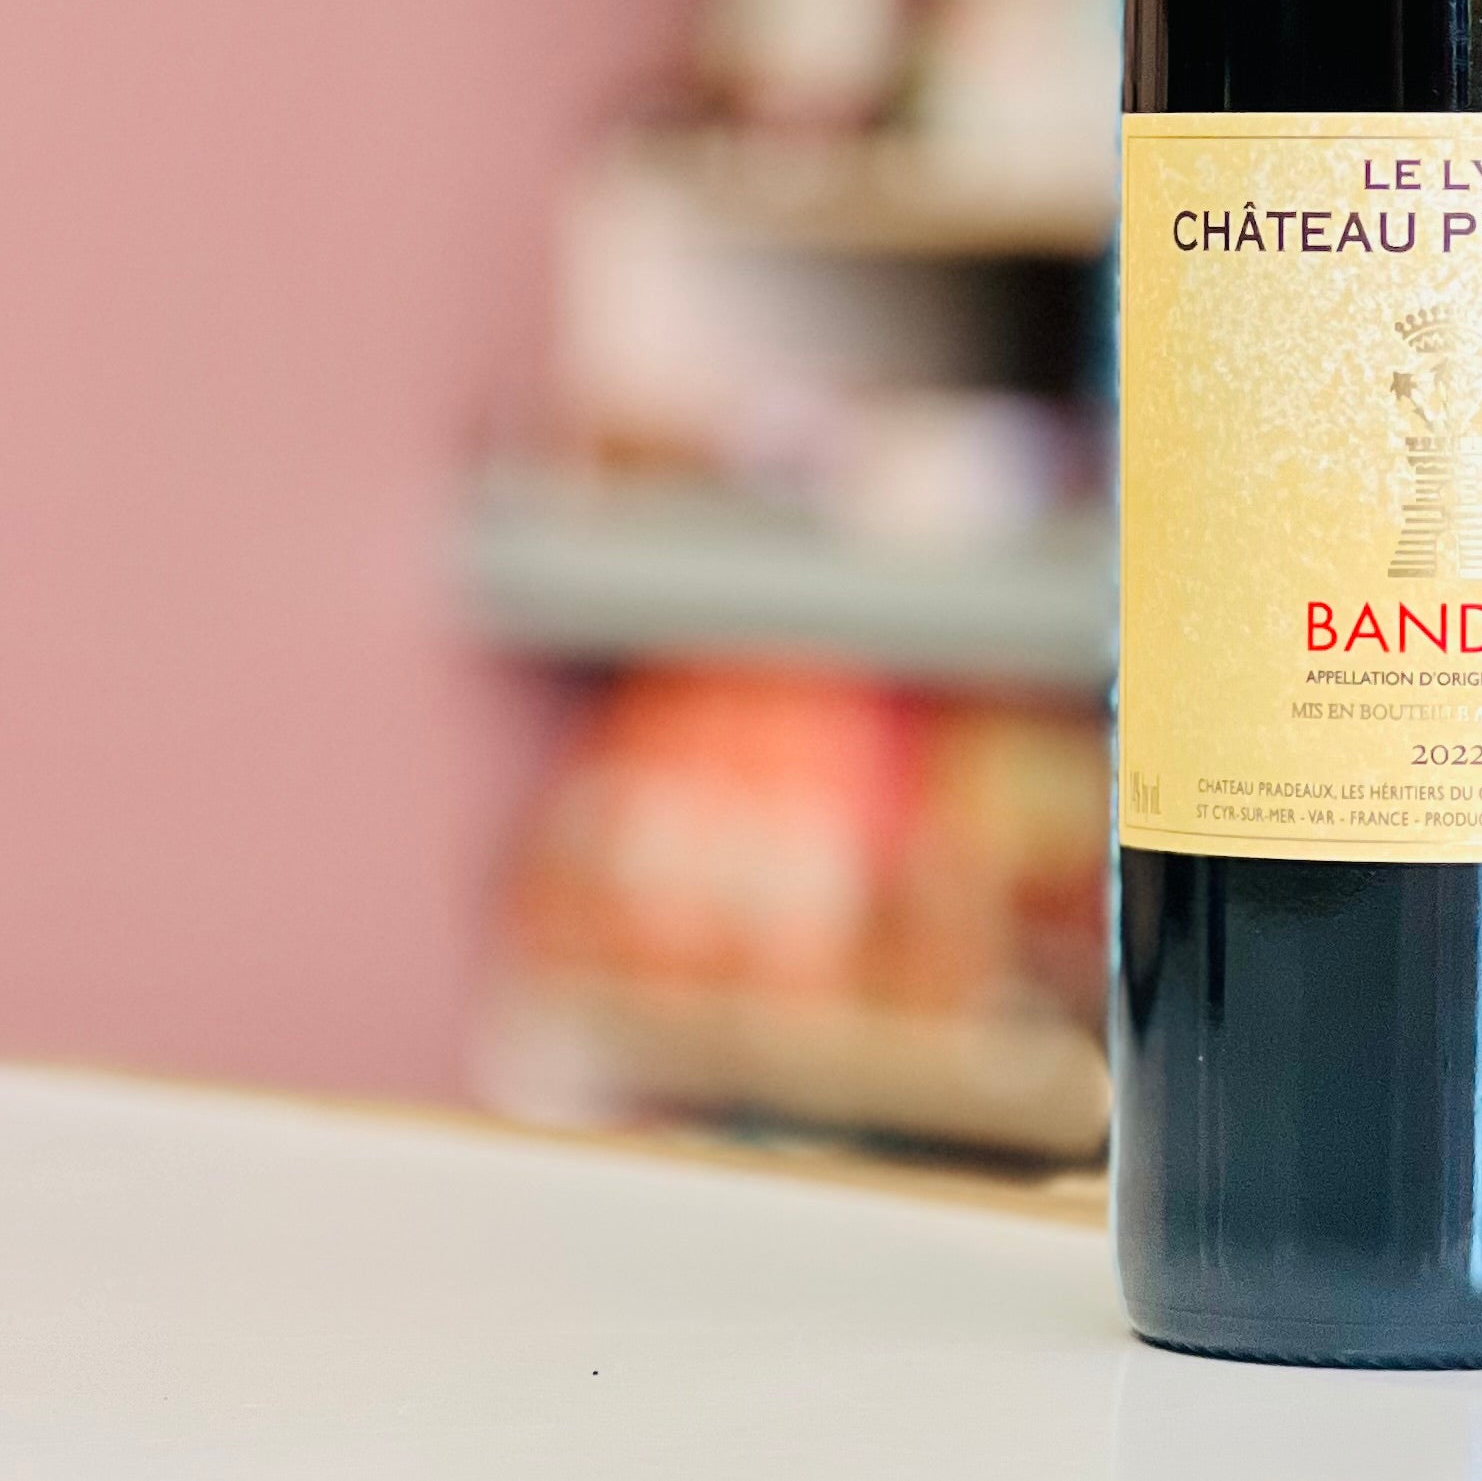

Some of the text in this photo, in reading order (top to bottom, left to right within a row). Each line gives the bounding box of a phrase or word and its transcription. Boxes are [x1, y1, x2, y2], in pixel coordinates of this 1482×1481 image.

[1363, 158, 1421, 190] LE
[1172, 201, 1416, 253] CHÂTEAU
[1306, 670, 1414, 686] APPELLATION
[1291, 701, 1324, 719] MIS
[1327, 702, 1355, 719] EN
[1198, 777, 1254, 797] CHATEAU
[1341, 784, 1365, 801] LES
[1369, 781, 1445, 802] HÉRITIERS
[1450, 785, 1473, 802] DU
[1196, 805, 1209, 819] ST
[1212, 805, 1296, 824] CYR-SUR-MER
[1308, 810, 1335, 825] VAR
[1349, 810, 1409, 826] FRANCE
